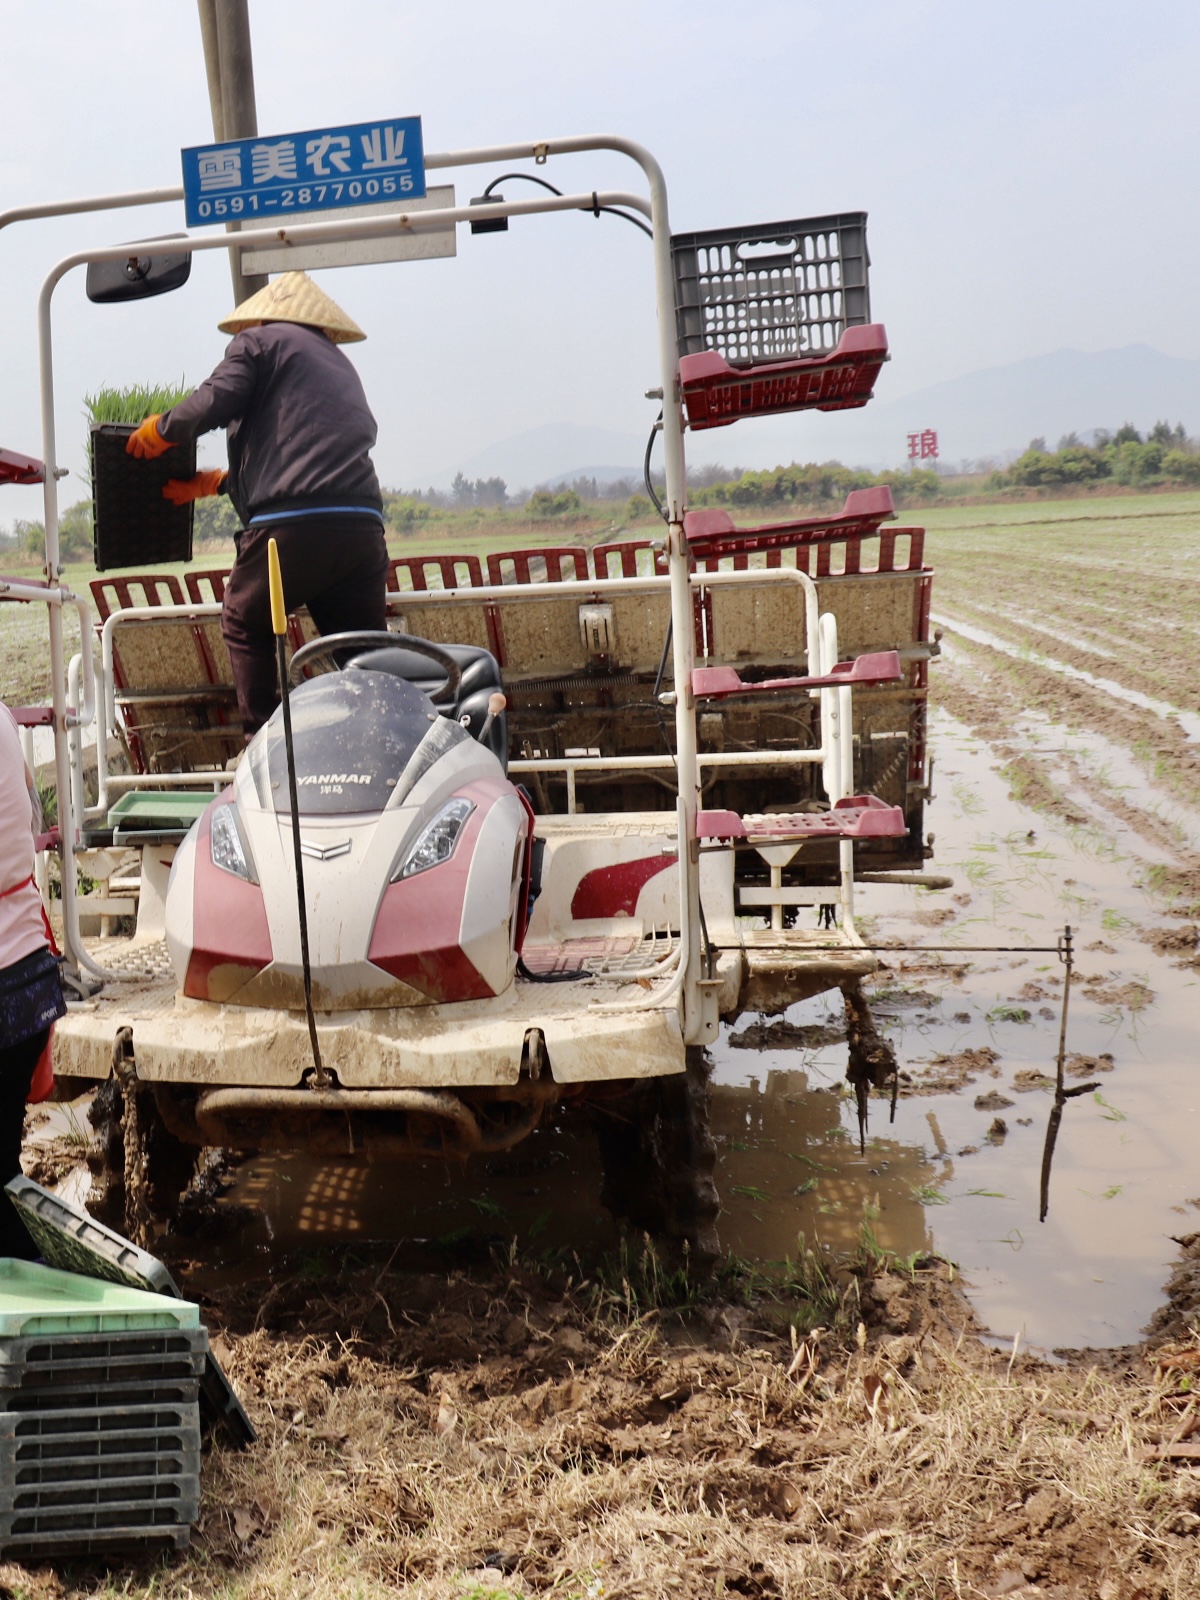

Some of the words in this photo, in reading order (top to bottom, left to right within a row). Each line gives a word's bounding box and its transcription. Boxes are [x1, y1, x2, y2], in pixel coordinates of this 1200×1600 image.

[197, 126, 408, 191] 雪美农业
[198, 175, 414, 217] 0591-28770055
[906, 428, 939, 459] 琅
[296, 773, 372, 786] YANMAR
[320, 784, 343, 795] 洋马
